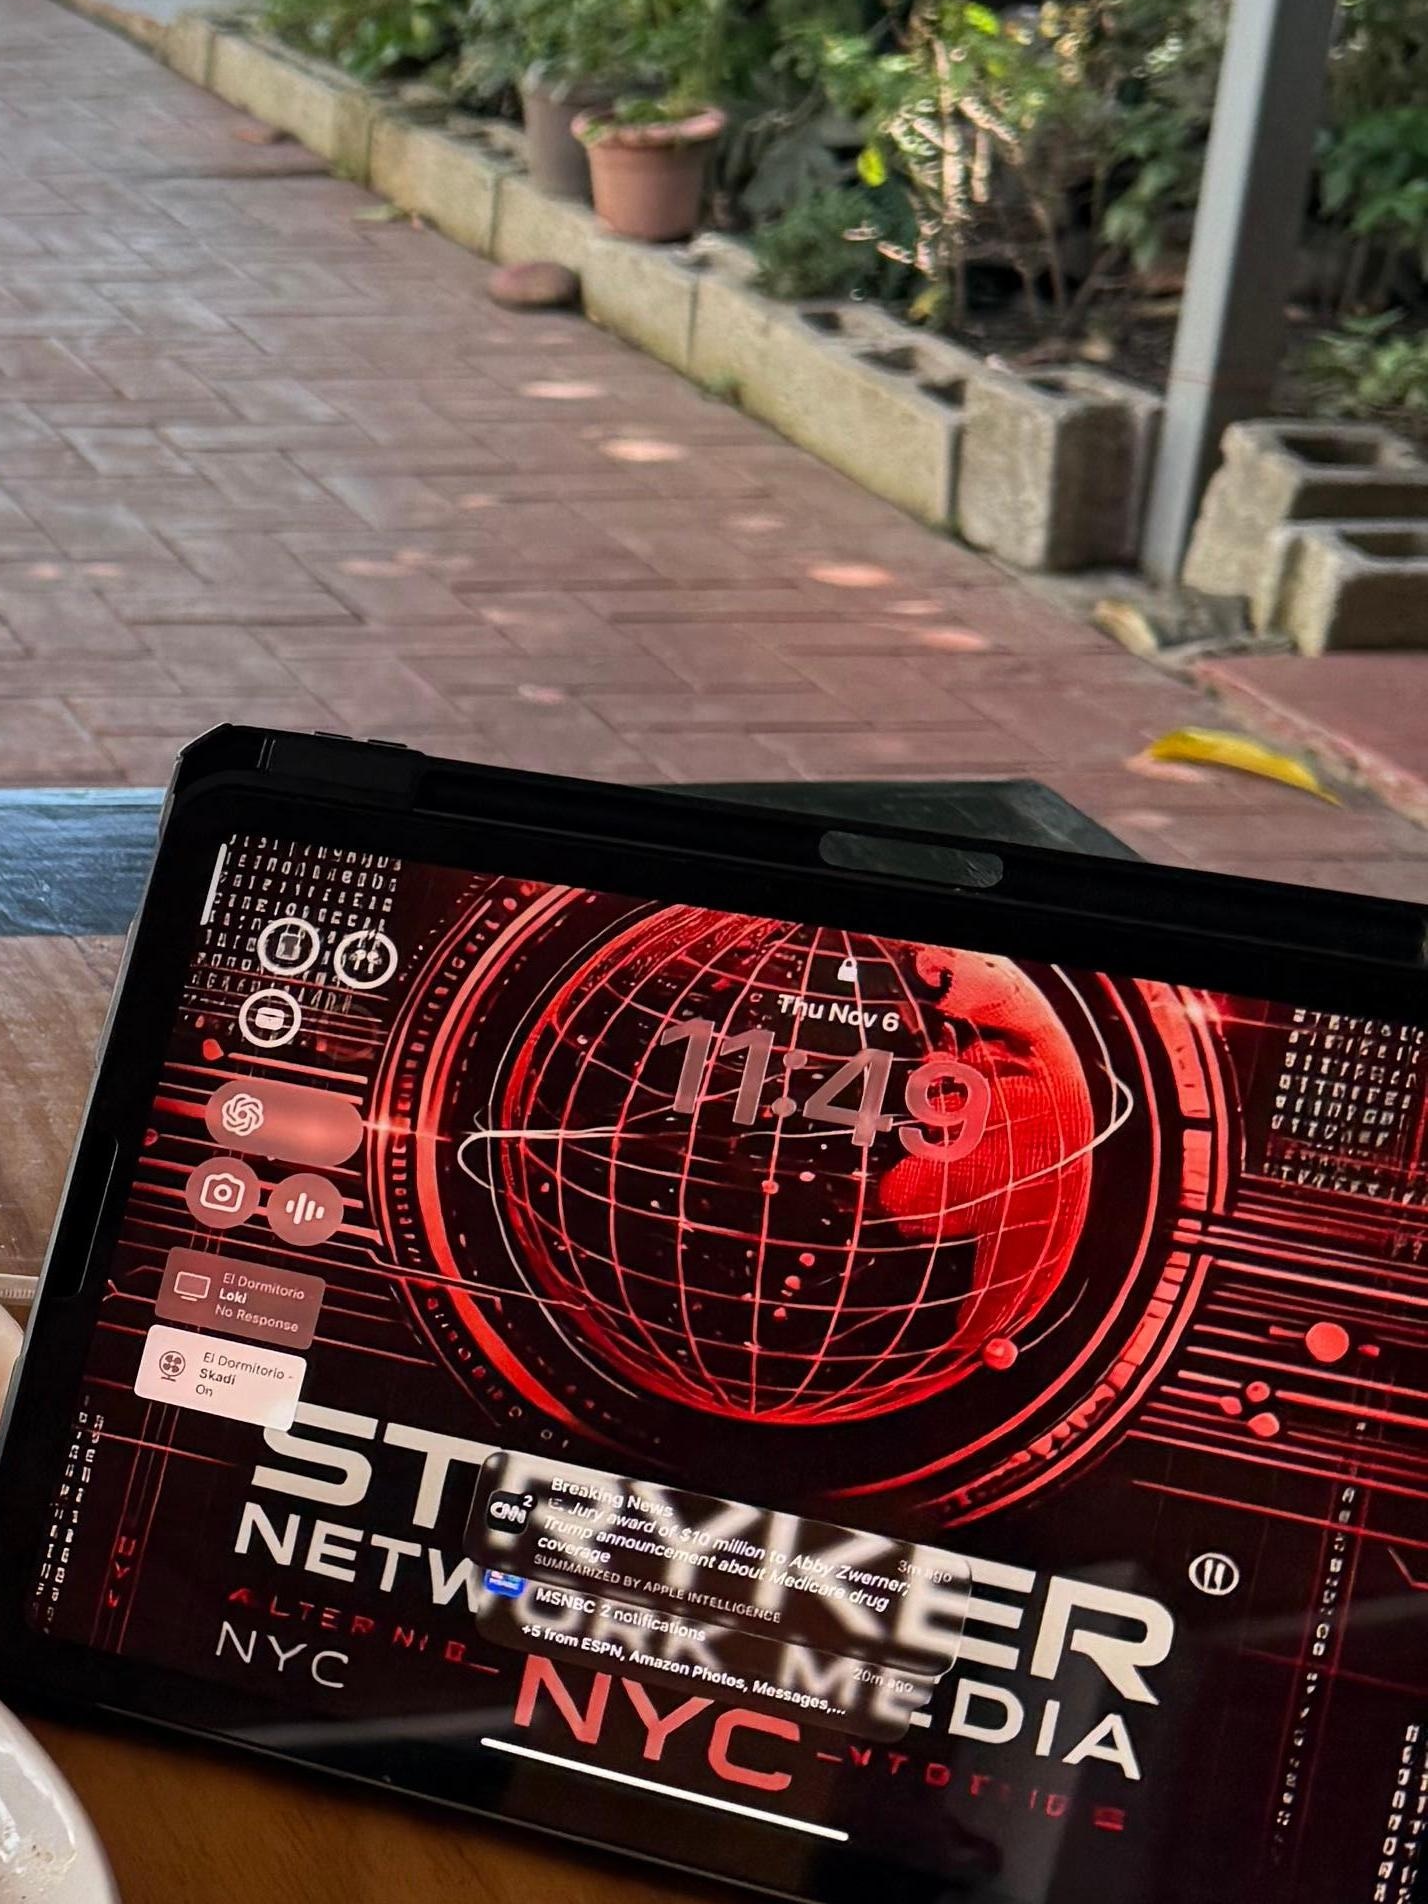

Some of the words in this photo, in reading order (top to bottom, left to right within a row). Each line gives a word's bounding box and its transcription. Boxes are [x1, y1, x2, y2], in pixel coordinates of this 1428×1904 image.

[777, 994, 824, 1021] Thu
[828, 1002, 878, 1028] Nov
[882, 1012, 900, 1032] 6
[660, 1018, 992, 1162] 11:49
[219, 1287, 247, 1304] Loki
[223, 1272, 236, 1285] El
[238, 1276, 305, 1300] Dormitorio
[215, 1304, 233, 1317] No
[236, 1309, 299, 1332] Response
[199, 1368, 237, 1385] Skadi
[203, 1352, 215, 1364] El
[218, 1355, 285, 1380] Dormitorio
[195, 1384, 213, 1397] On
[523, 1495, 533, 1507] 2
[551, 1477, 624, 1508] Breaking
[627, 1495, 674, 1517] News
[490, 1501, 527, 1524] CNN
[538, 1537, 611, 1564] coverage
[568, 1502, 604, 1523] Jury
[607, 1513, 657, 1533] award
[658, 1525, 679, 1538] of
[680, 1527, 711, 1546] $10
[713, 1538, 766, 1561] million
[769, 1550, 786, 1564] to
[789, 1554, 833, 1578] Abby
[836, 1565, 911, 1597] Zwerner;
[544, 1515, 594, 1539] Trump
[596, 1531, 716, 1569] announcement
[718, 1559, 766, 1580] about
[769, 1569, 846, 1597] Medicare
[849, 1589, 890, 1613] drug
[897, 1560, 922, 1575] 3m
[925, 1570, 952, 1584] ago
[534, 1553, 621, 1584] SUMMARIZED
[624, 1576, 642, 1589] BY
[643, 1581, 685, 1600] APPLE
[687, 1592, 782, 1624] INTELLIGENCE
[536, 1587, 596, 1614] MSNBC
[600, 1604, 611, 1618] 2
[613, 1610, 706, 1642] notifications
[215, 1621, 349, 1688] NYC
[522, 1625, 542, 1638] +5
[544, 1628, 579, 1648] from
[581, 1637, 625, 1662] ESPN,
[629, 1650, 690, 1676] Amazon
[692, 1665, 748, 1693] Photos,
[853, 1668, 884, 1686] 20m
[886, 1678, 913, 1694] ago
[514, 1654, 802, 1791] NYC
